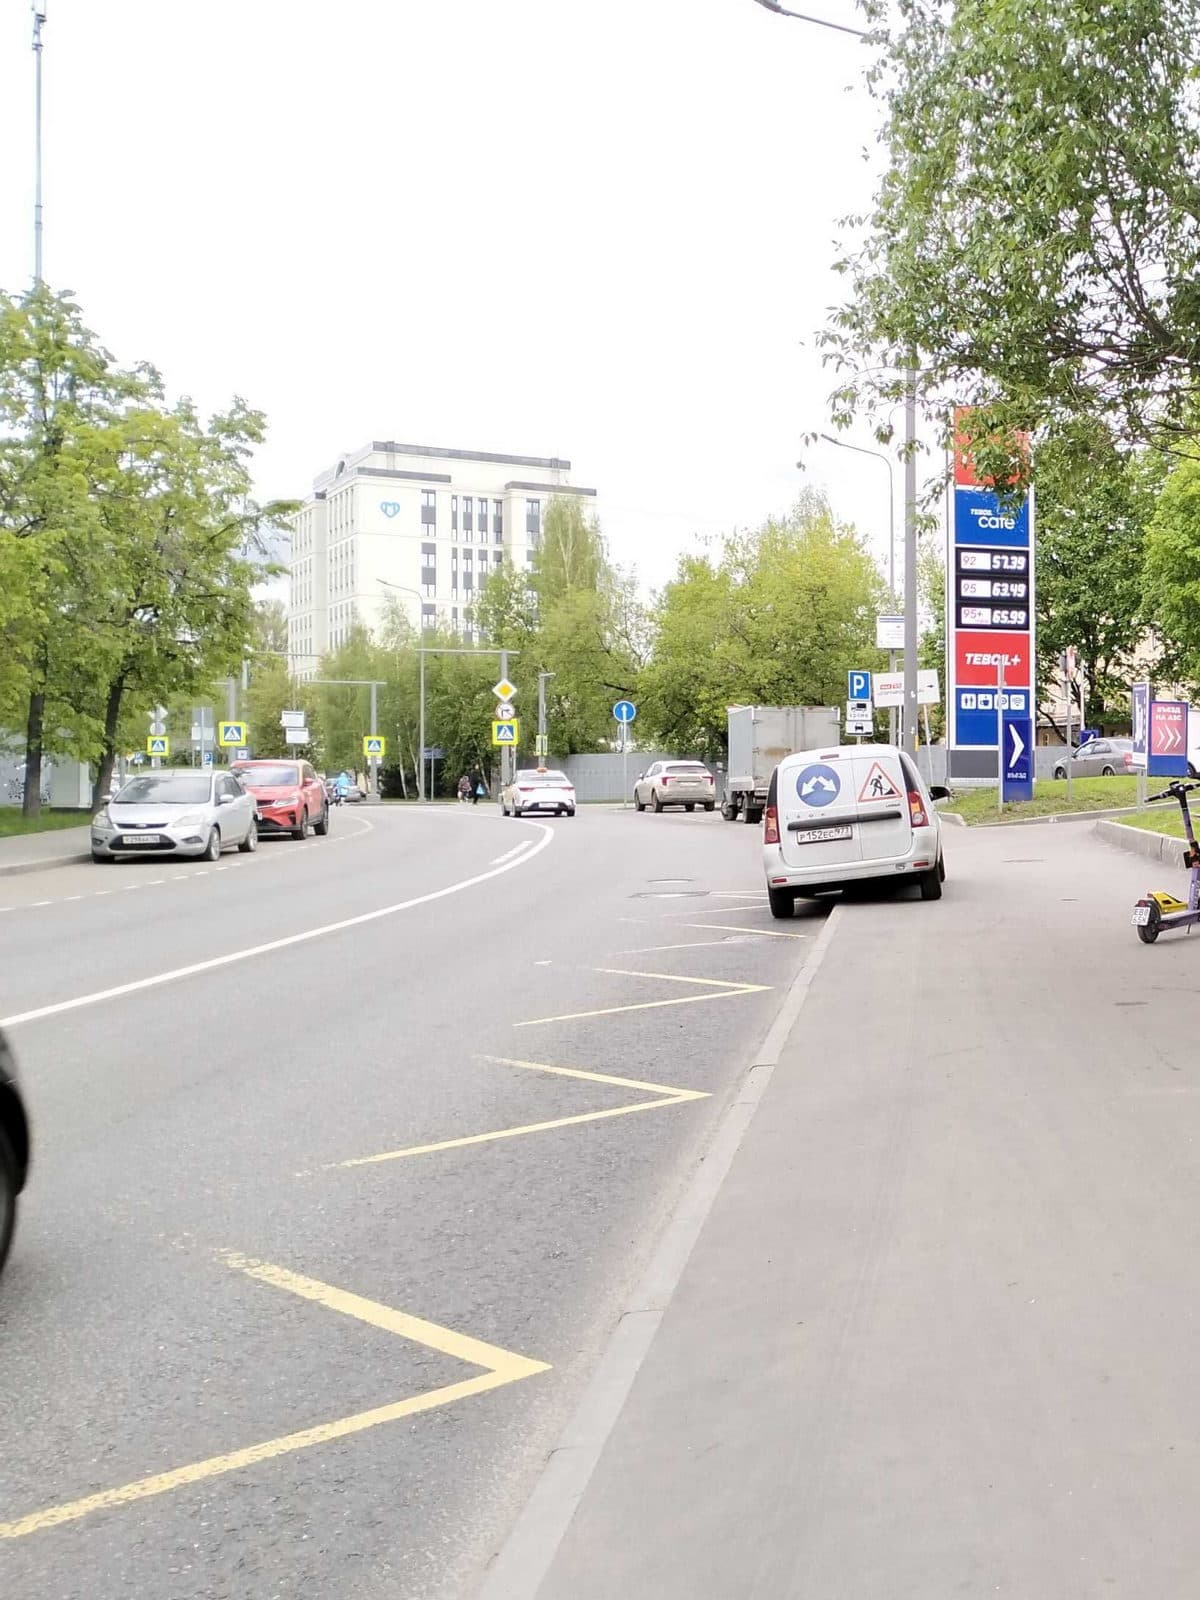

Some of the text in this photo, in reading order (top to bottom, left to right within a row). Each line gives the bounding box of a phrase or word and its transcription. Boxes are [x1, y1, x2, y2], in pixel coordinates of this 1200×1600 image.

[963, 555, 1026, 570] 92 57.39
[963, 583, 1026, 597] 95 63.49
[964, 609, 1026, 624] 95+ 65.99
